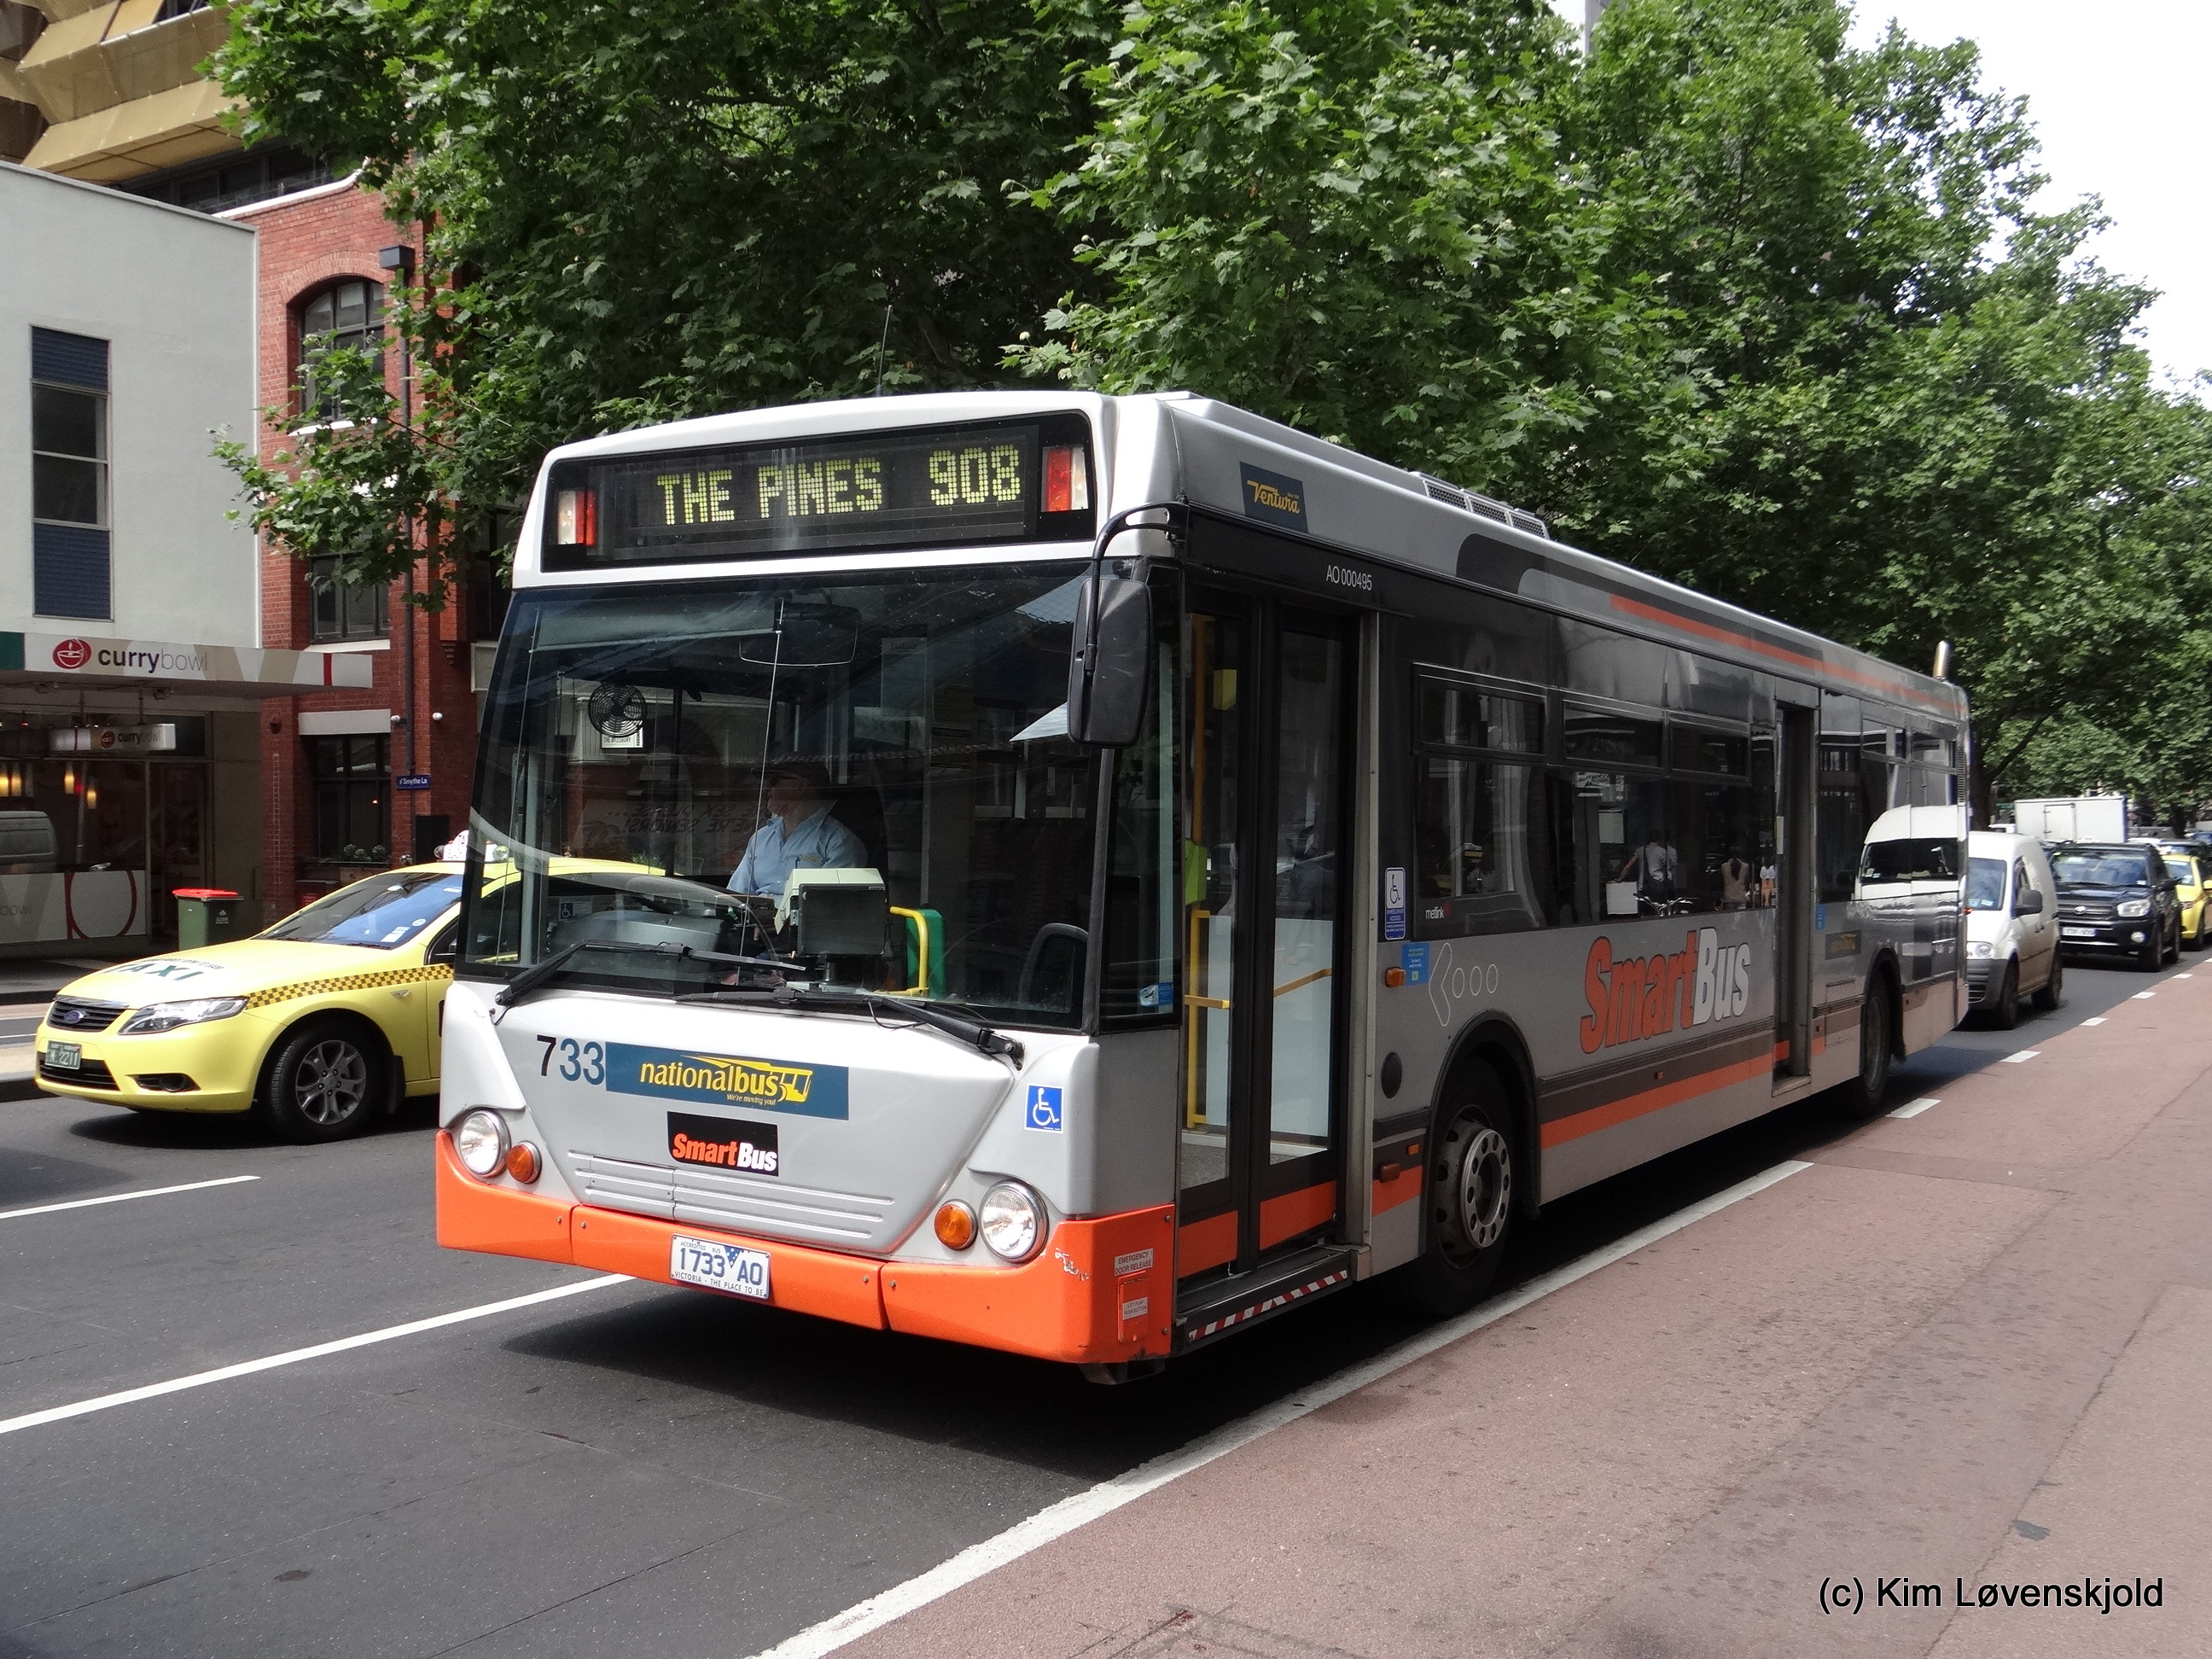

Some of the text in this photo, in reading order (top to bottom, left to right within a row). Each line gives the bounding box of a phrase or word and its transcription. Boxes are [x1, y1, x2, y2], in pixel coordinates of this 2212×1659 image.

[657, 444, 1021, 525] THE PINES 908
[1247, 480, 1301, 514] Ventura
[1341, 568, 1372, 591] 000495
[97, 645, 208, 674] currybowl
[1580, 928, 1751, 1054] SmartBus
[536, 1034, 606, 1086] 733
[640, 1061, 780, 1097] nationalbus
[672, 1133, 778, 1173] SmartBus
[680, 1241, 707, 1251] ACCREDITED
[1118, 1250, 1150, 1264] EMERGENCY
[680, 1248, 725, 1278] 1733
[1115, 1260, 1151, 1275] DOOR RELEASE
[674, 1271, 701, 1283] VICTORIA
[710, 1278, 721, 1287] THE
[724, 1282, 742, 1291] PLACE
